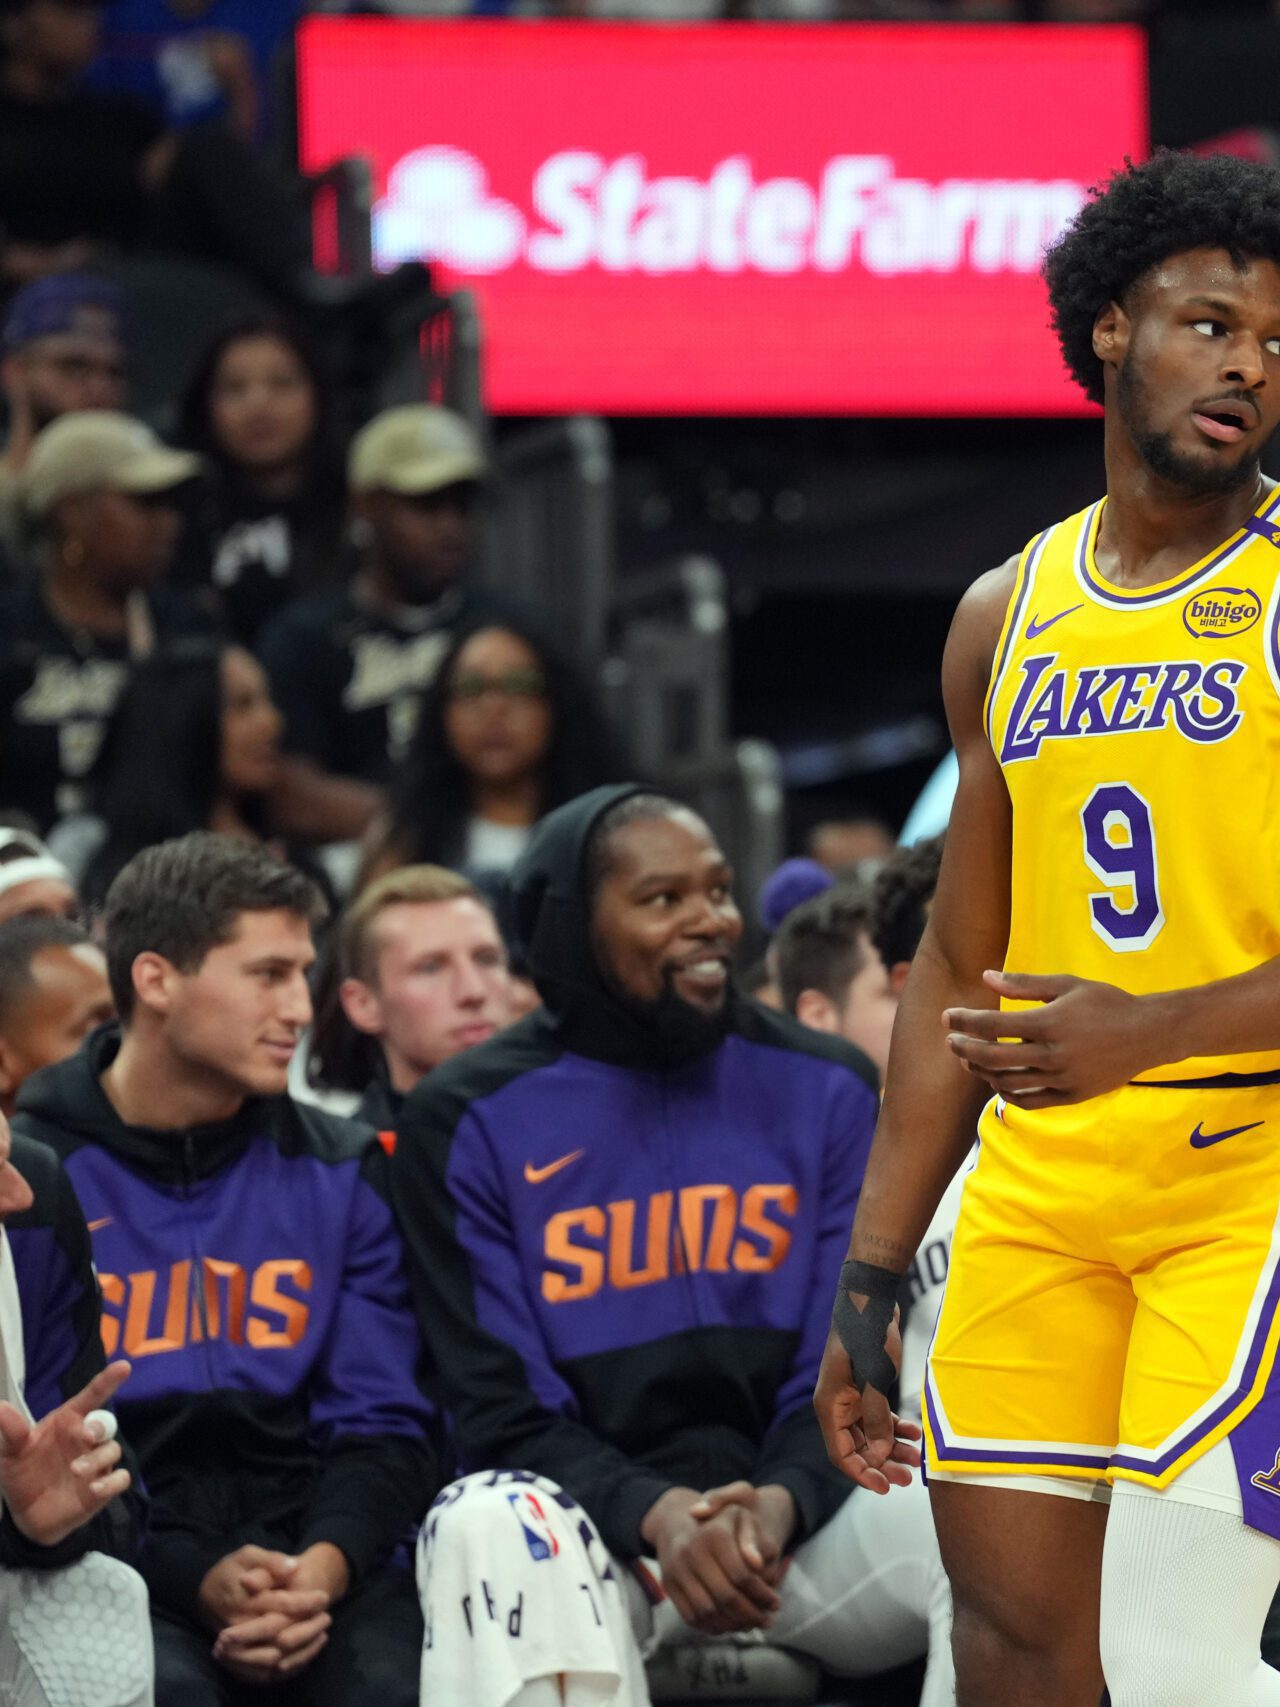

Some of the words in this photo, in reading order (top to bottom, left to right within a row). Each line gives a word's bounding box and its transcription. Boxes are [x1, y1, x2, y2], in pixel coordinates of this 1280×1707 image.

[1191, 601, 1257, 623] bibigo
[1199, 618, 1227, 628] 비비고
[1001, 652, 1248, 766] LAKERS
[1079, 781, 1166, 953] 9
[541, 1184, 798, 1304] SUNS
